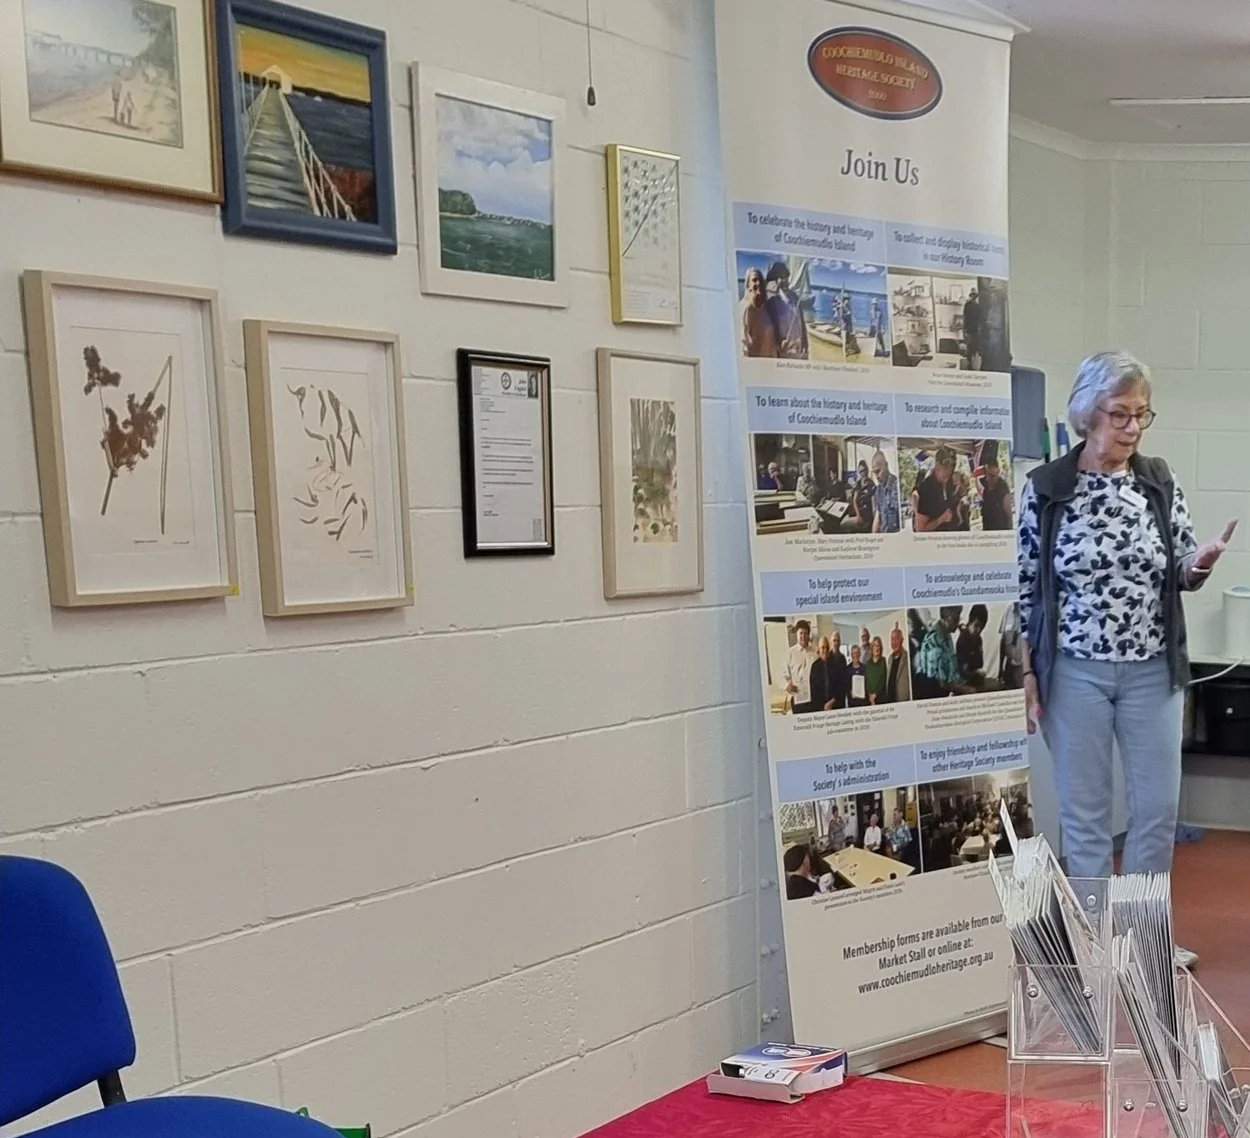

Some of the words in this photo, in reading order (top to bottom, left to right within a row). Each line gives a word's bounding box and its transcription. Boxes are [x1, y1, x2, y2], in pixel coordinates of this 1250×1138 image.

[836, 63, 879, 82] HERITAGE
[840, 148, 888, 182] Join
[893, 157, 920, 186] Us
[747, 211, 758, 224] To
[759, 213, 793, 229] celebrate
[894, 230, 903, 242] To
[755, 395, 767, 407] To
[768, 396, 789, 408] learn
[790, 397, 810, 409] about
[810, 398, 822, 409] the
[823, 398, 847, 413] history
[848, 400, 861, 411] and
[905, 402, 913, 412] To
[788, 411, 796, 424] of
[846, 415, 868, 427] Island
[808, 579, 816, 590] To
[817, 578, 832, 591] help
[833, 578, 857, 591] protect
[858, 579, 870, 588] our
[924, 572, 933, 583] To
[795, 592, 819, 608] special
[820, 592, 840, 604] island
[840, 591, 883, 604] environment
[920, 749, 928, 760] To
[928, 748, 946, 764] enjoy
[946, 744, 976, 757] friendship
[976, 741, 988, 753] and
[825, 763, 833, 775] To
[834, 761, 848, 774] help
[848, 759, 864, 771] with
[865, 757, 877, 769] the
[932, 761, 949, 773] other
[949, 758, 974, 771] Heritage
[842, 771, 890, 787] administration
[842, 936, 896, 960] Membership
[896, 932, 920, 948] forms
[921, 929, 935, 942] are
[935, 918, 970, 939] available
[970, 915, 989, 930] from
[990, 913, 1003, 925] our
[878, 951, 908, 970] Market
[908, 948, 926, 964] Stall
[927, 946, 937, 958] or
[937, 940, 962, 956] online
[858, 950, 994, 995] www.coochiemudloheritage.org.au
